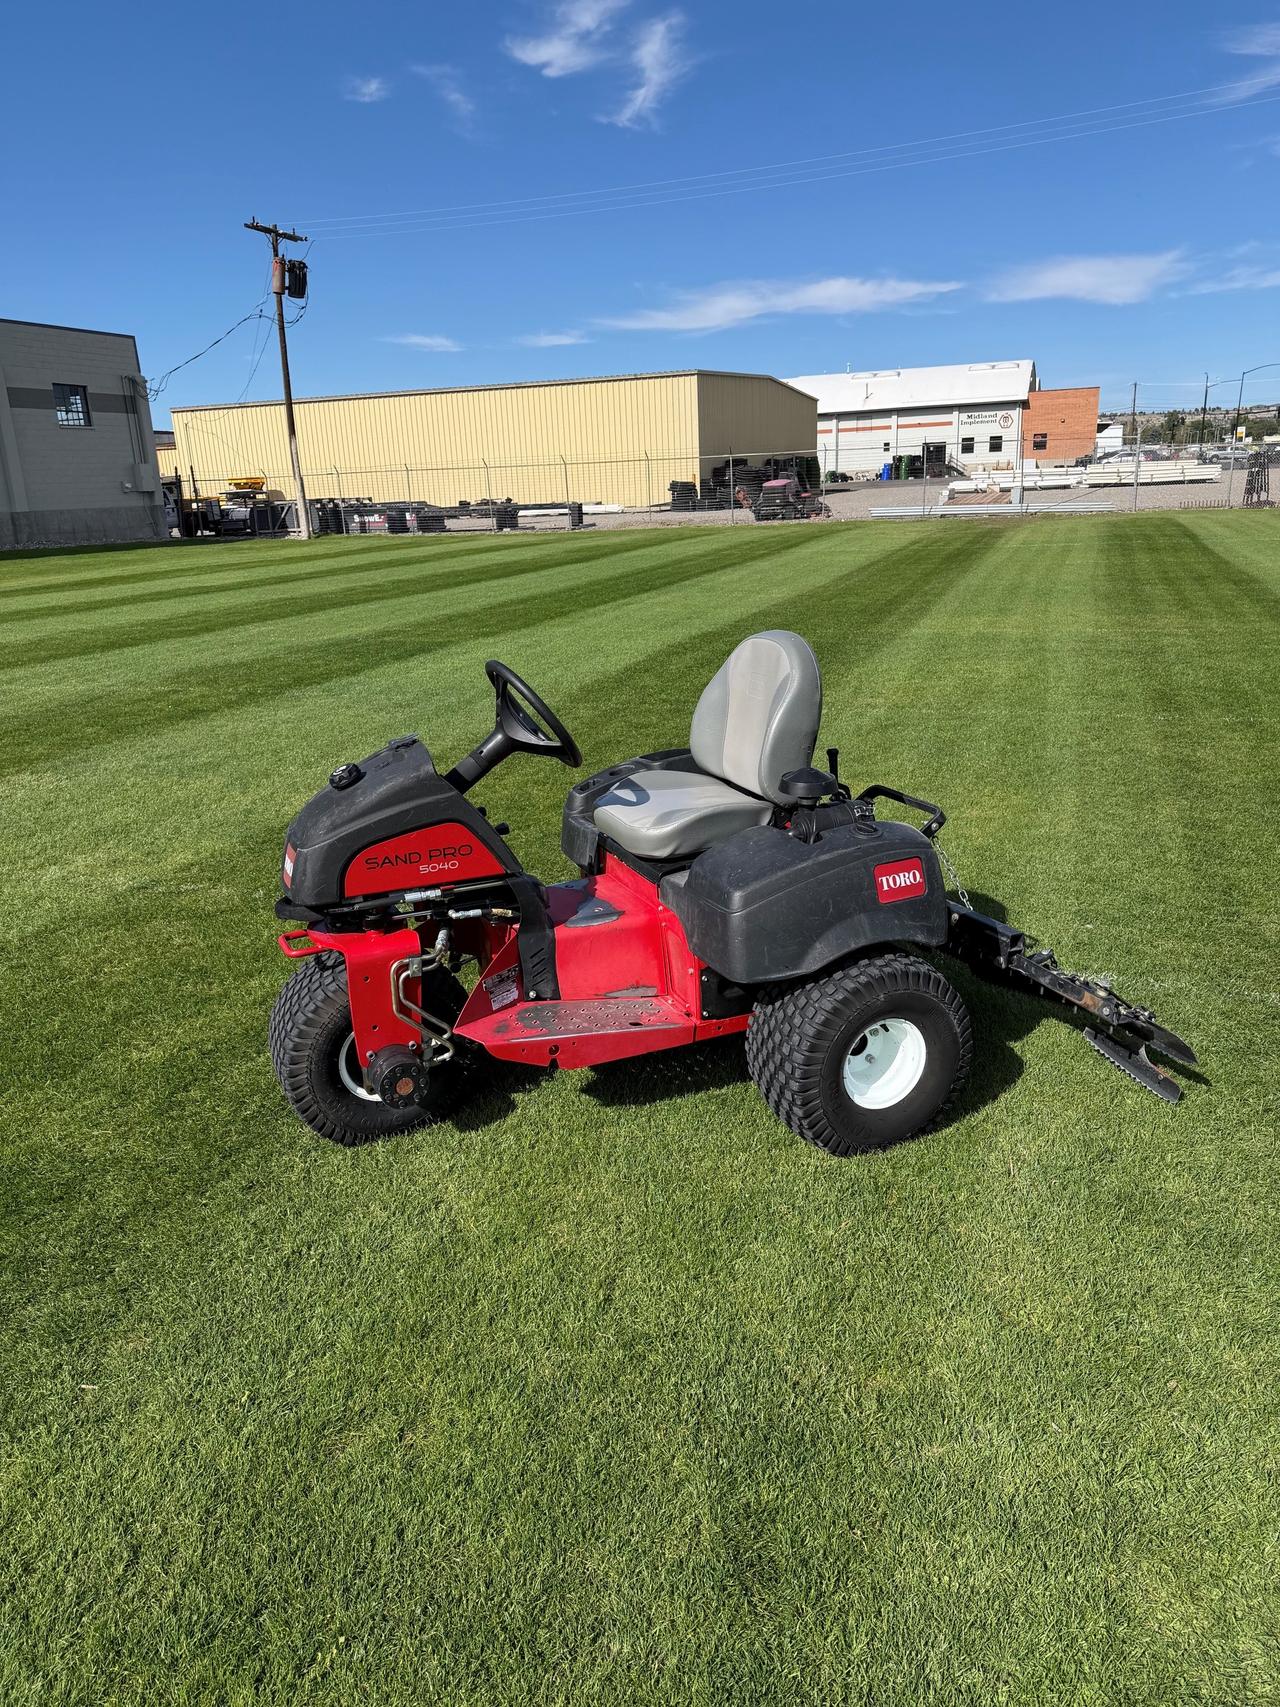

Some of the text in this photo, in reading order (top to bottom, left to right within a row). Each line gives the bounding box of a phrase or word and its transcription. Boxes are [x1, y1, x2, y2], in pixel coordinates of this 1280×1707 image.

[960, 418, 998, 426] Implement
[966, 412, 998, 420] Midland
[364, 844, 473, 871] SAND PRO
[419, 860, 459, 874] 5040
[878, 869, 921, 892] TORO
